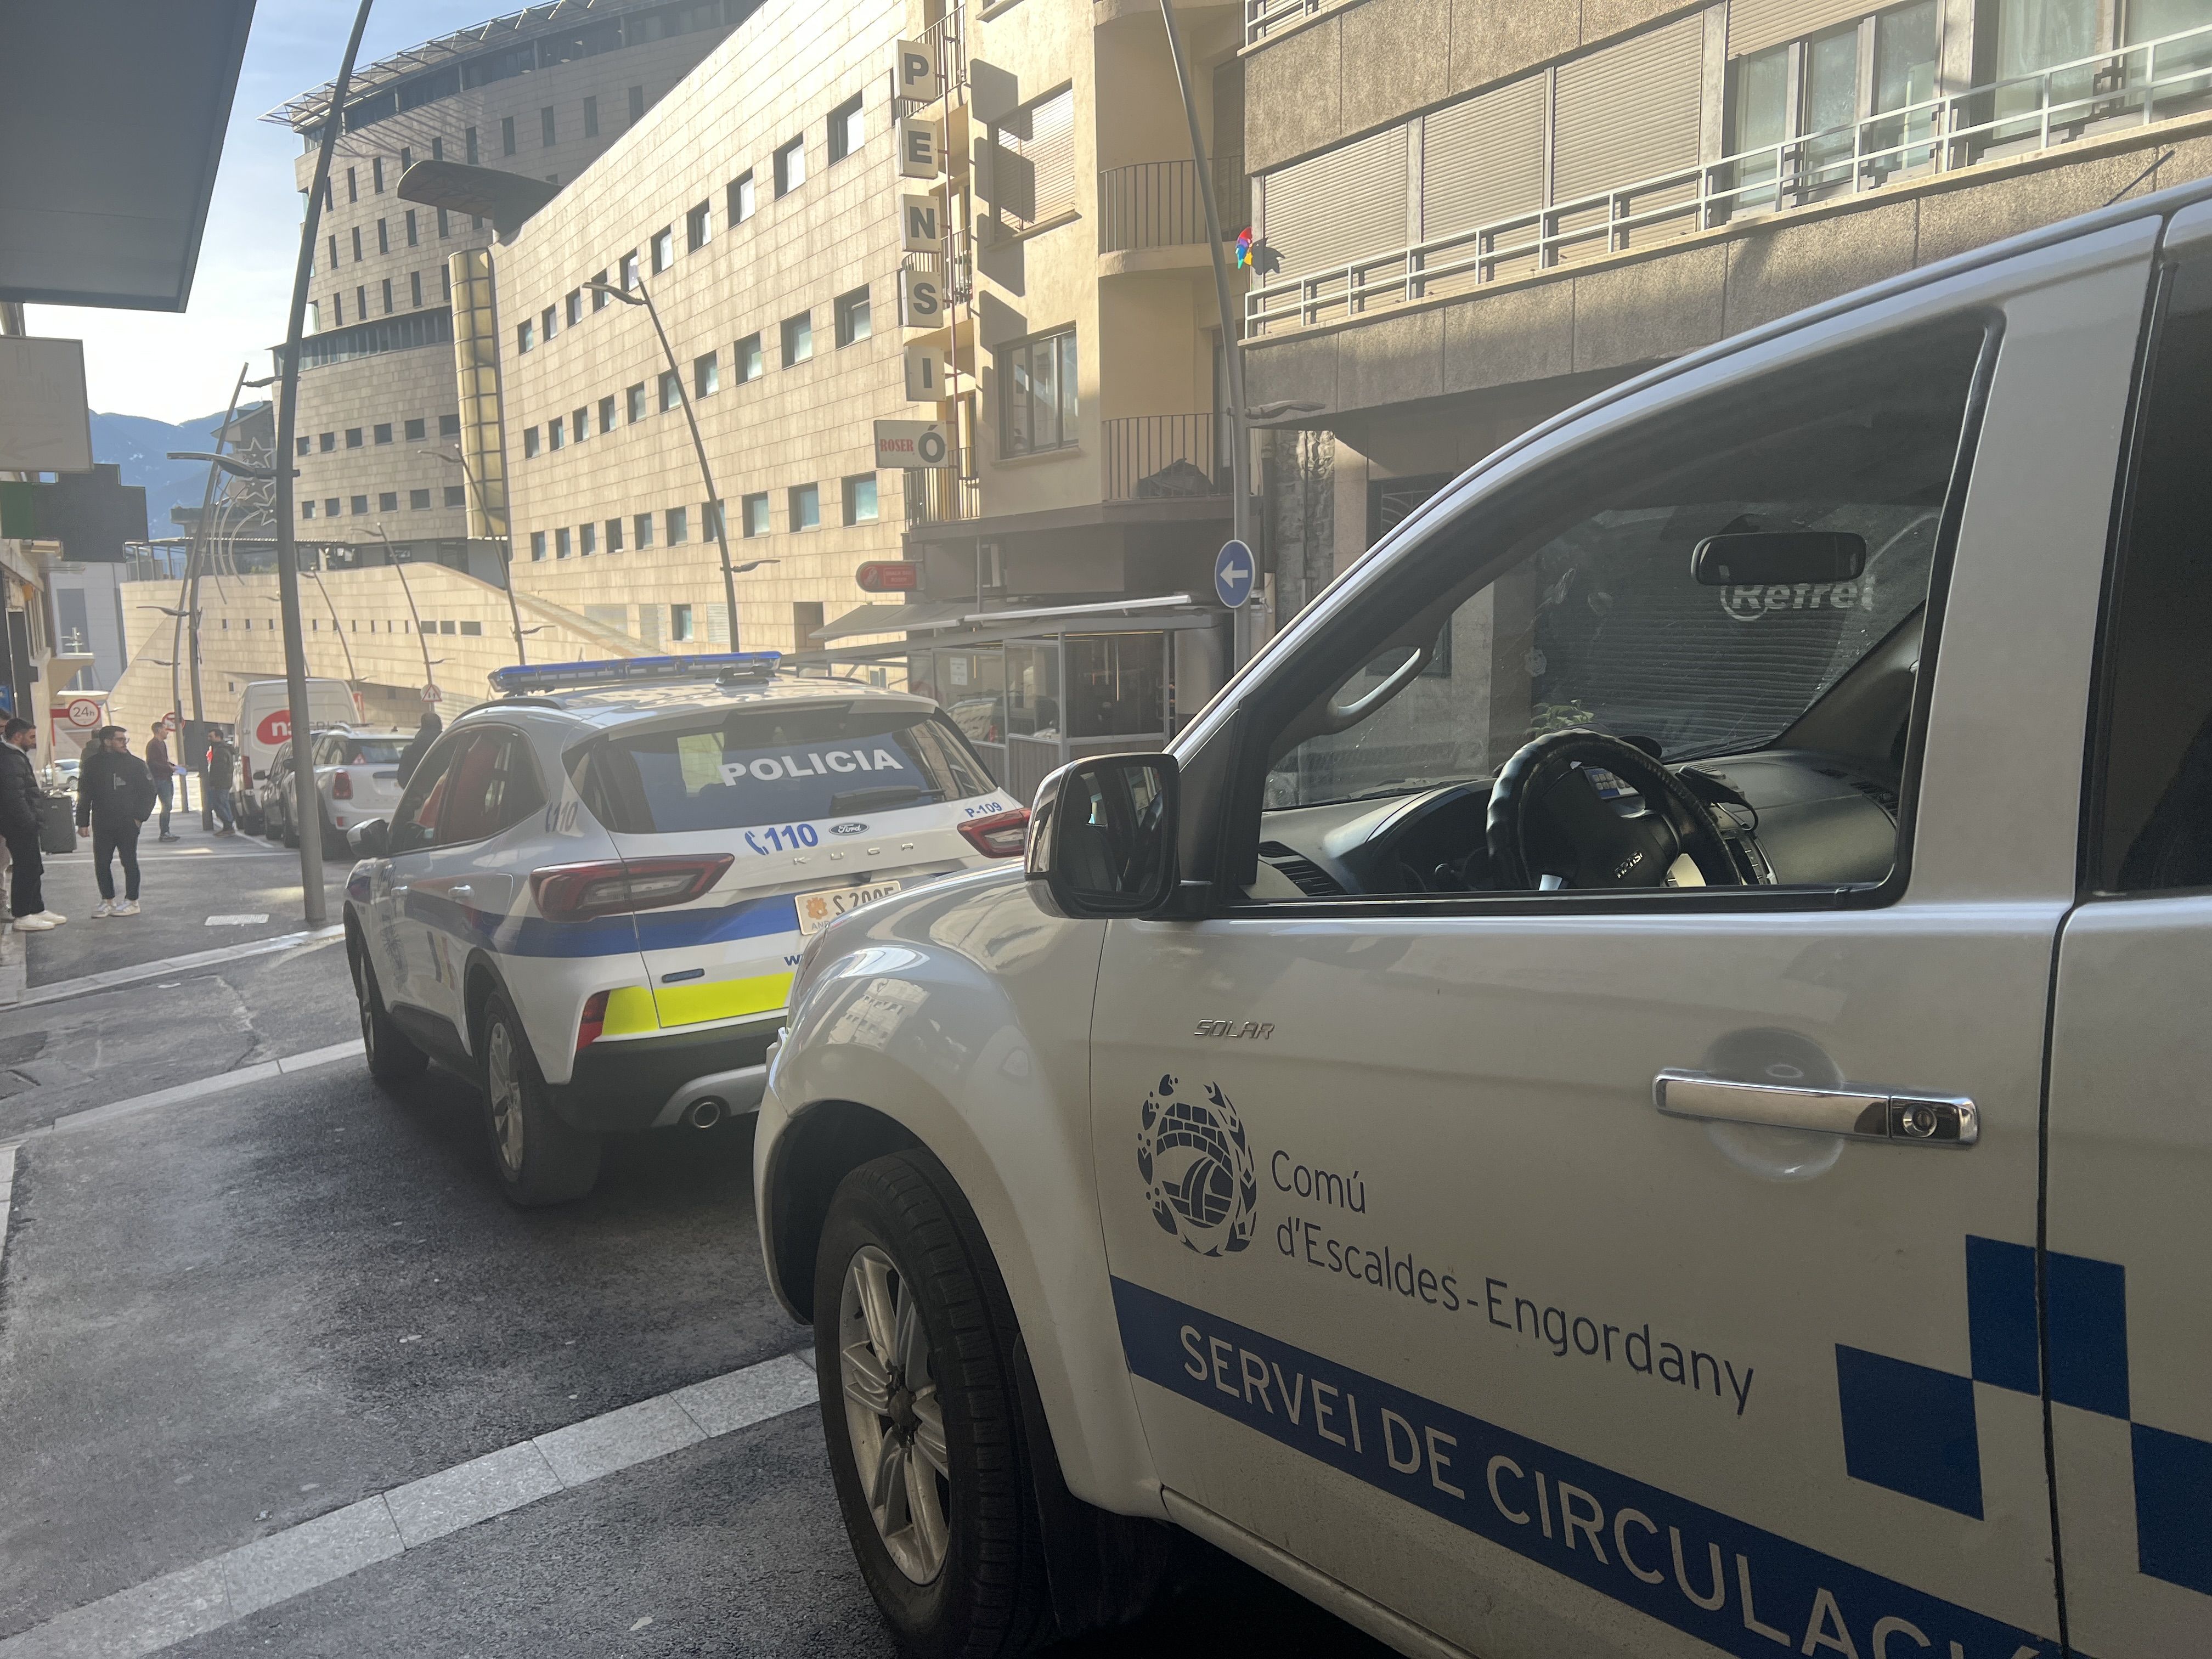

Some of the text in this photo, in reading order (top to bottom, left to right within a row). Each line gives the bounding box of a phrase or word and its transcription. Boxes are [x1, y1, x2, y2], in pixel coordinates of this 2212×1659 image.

[879, 438, 914, 452] ROSER
[73, 706, 95, 717] 24h
[717, 749, 905, 787] POLICIA
[964, 802, 1002, 817] P-109
[764, 823, 819, 851] 110
[838, 823, 862, 834] Ford
[1194, 1019, 1275, 1040] SOLAR
[1271, 1150, 1365, 1214] Comú
[1277, 1216, 1754, 1416] d'Escaldes-Engordany
[1180, 1325, 1362, 1454] SERVEI
[1380, 1407, 1465, 1500] DE
